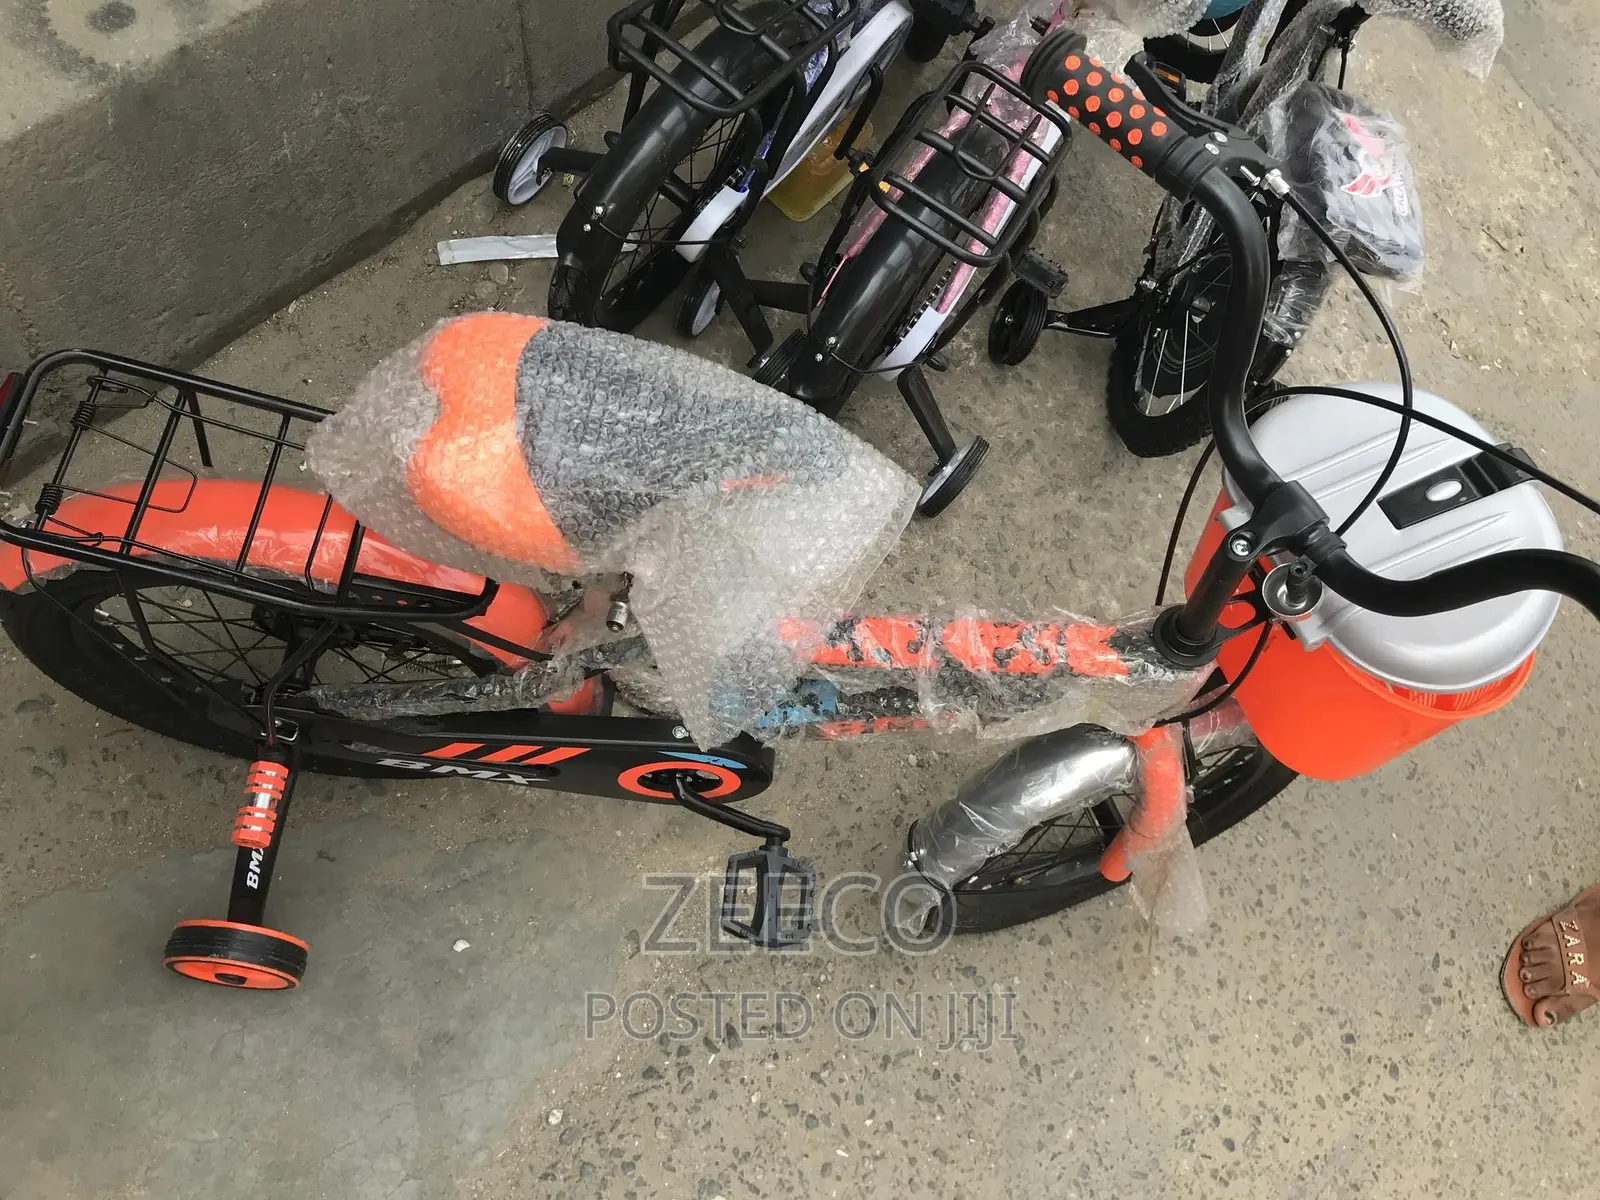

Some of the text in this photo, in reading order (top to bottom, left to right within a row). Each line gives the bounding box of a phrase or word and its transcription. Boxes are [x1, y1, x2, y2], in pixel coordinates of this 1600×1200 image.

[375, 758, 550, 786] BMX
[246, 847, 264, 890] BM
[1560, 920, 1591, 988] ZARA
